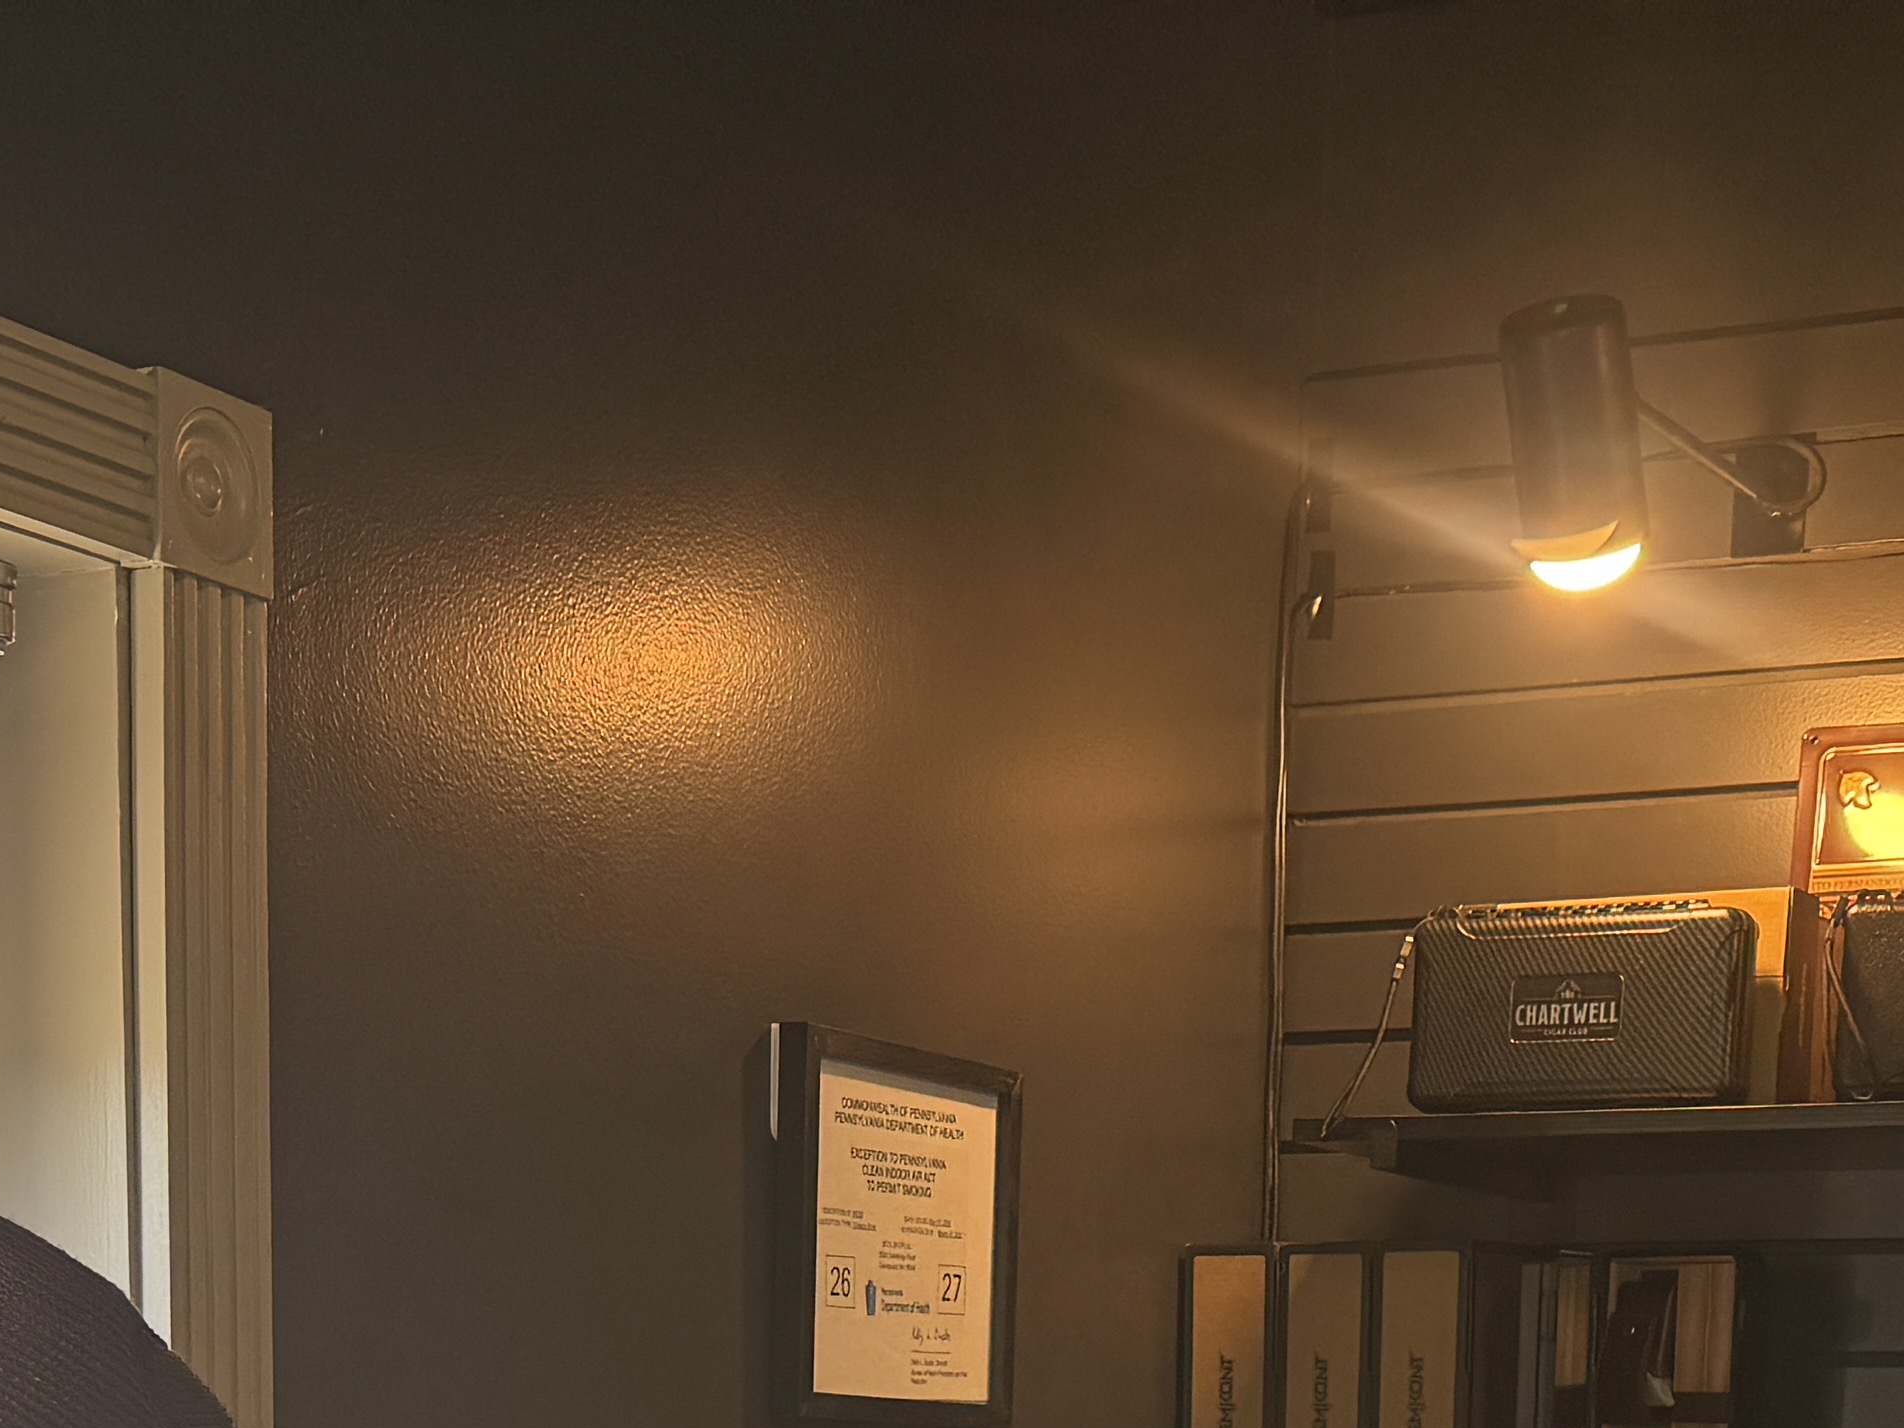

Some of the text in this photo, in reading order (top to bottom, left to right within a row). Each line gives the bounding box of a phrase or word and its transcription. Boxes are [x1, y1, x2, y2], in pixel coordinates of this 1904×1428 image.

[1516, 1001, 1619, 1026] CHARTWELL
[830, 1266, 851, 1297] 26
[942, 1272, 962, 1303] 27
